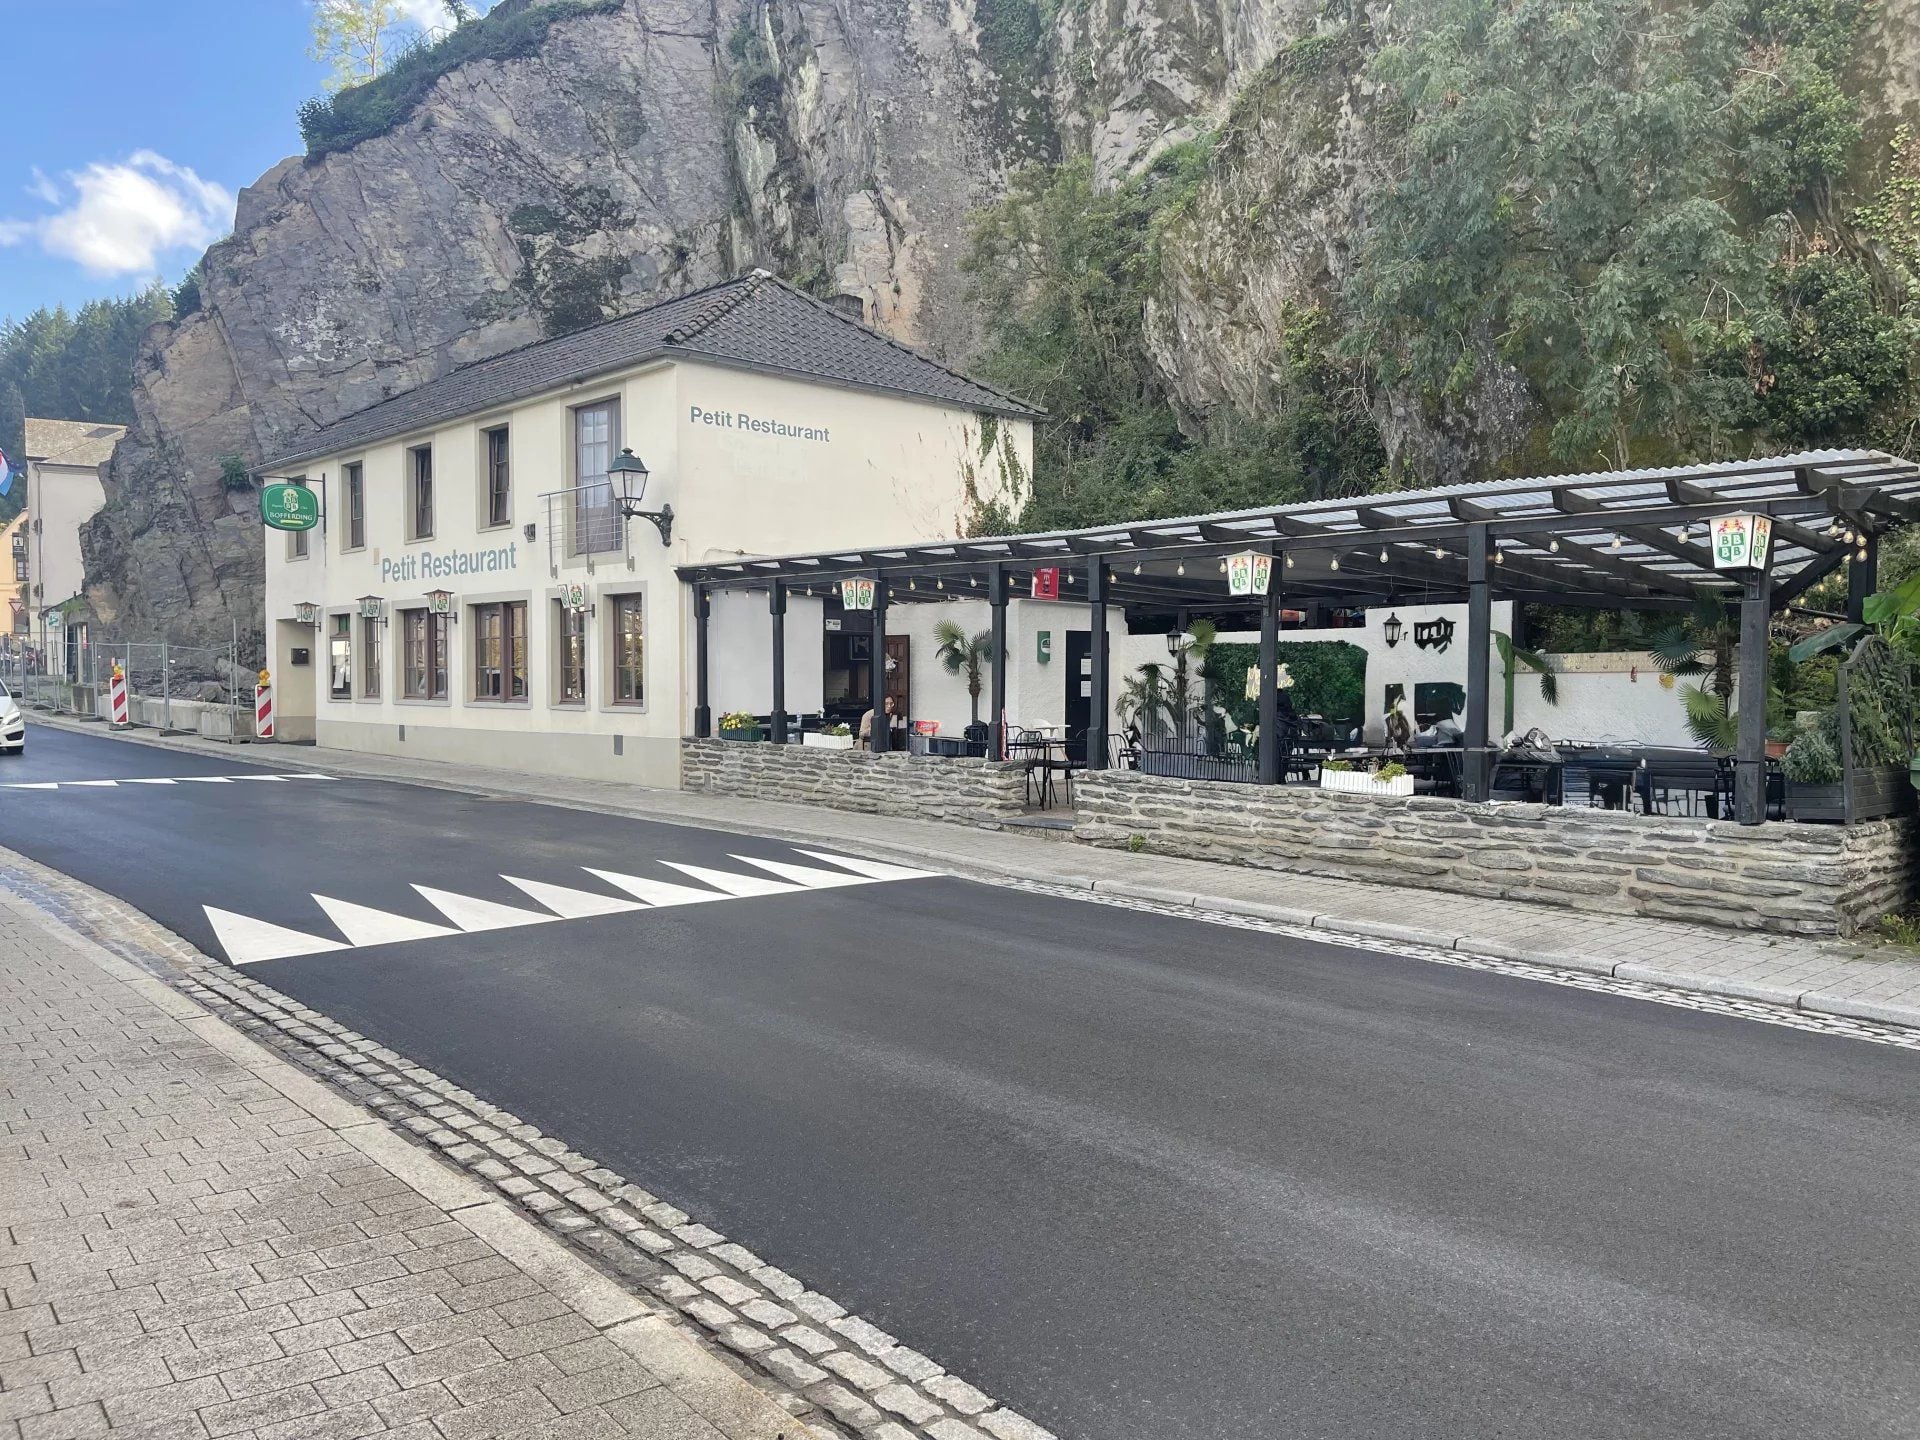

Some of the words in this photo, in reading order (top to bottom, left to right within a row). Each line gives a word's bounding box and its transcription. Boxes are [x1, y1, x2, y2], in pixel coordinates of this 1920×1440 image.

[690, 406, 732, 428] Petit
[738, 413, 830, 443] Restaurant
[270, 511, 313, 521] BOFFERDING
[382, 555, 416, 583] Petit
[421, 541, 516, 578] Restaurant
